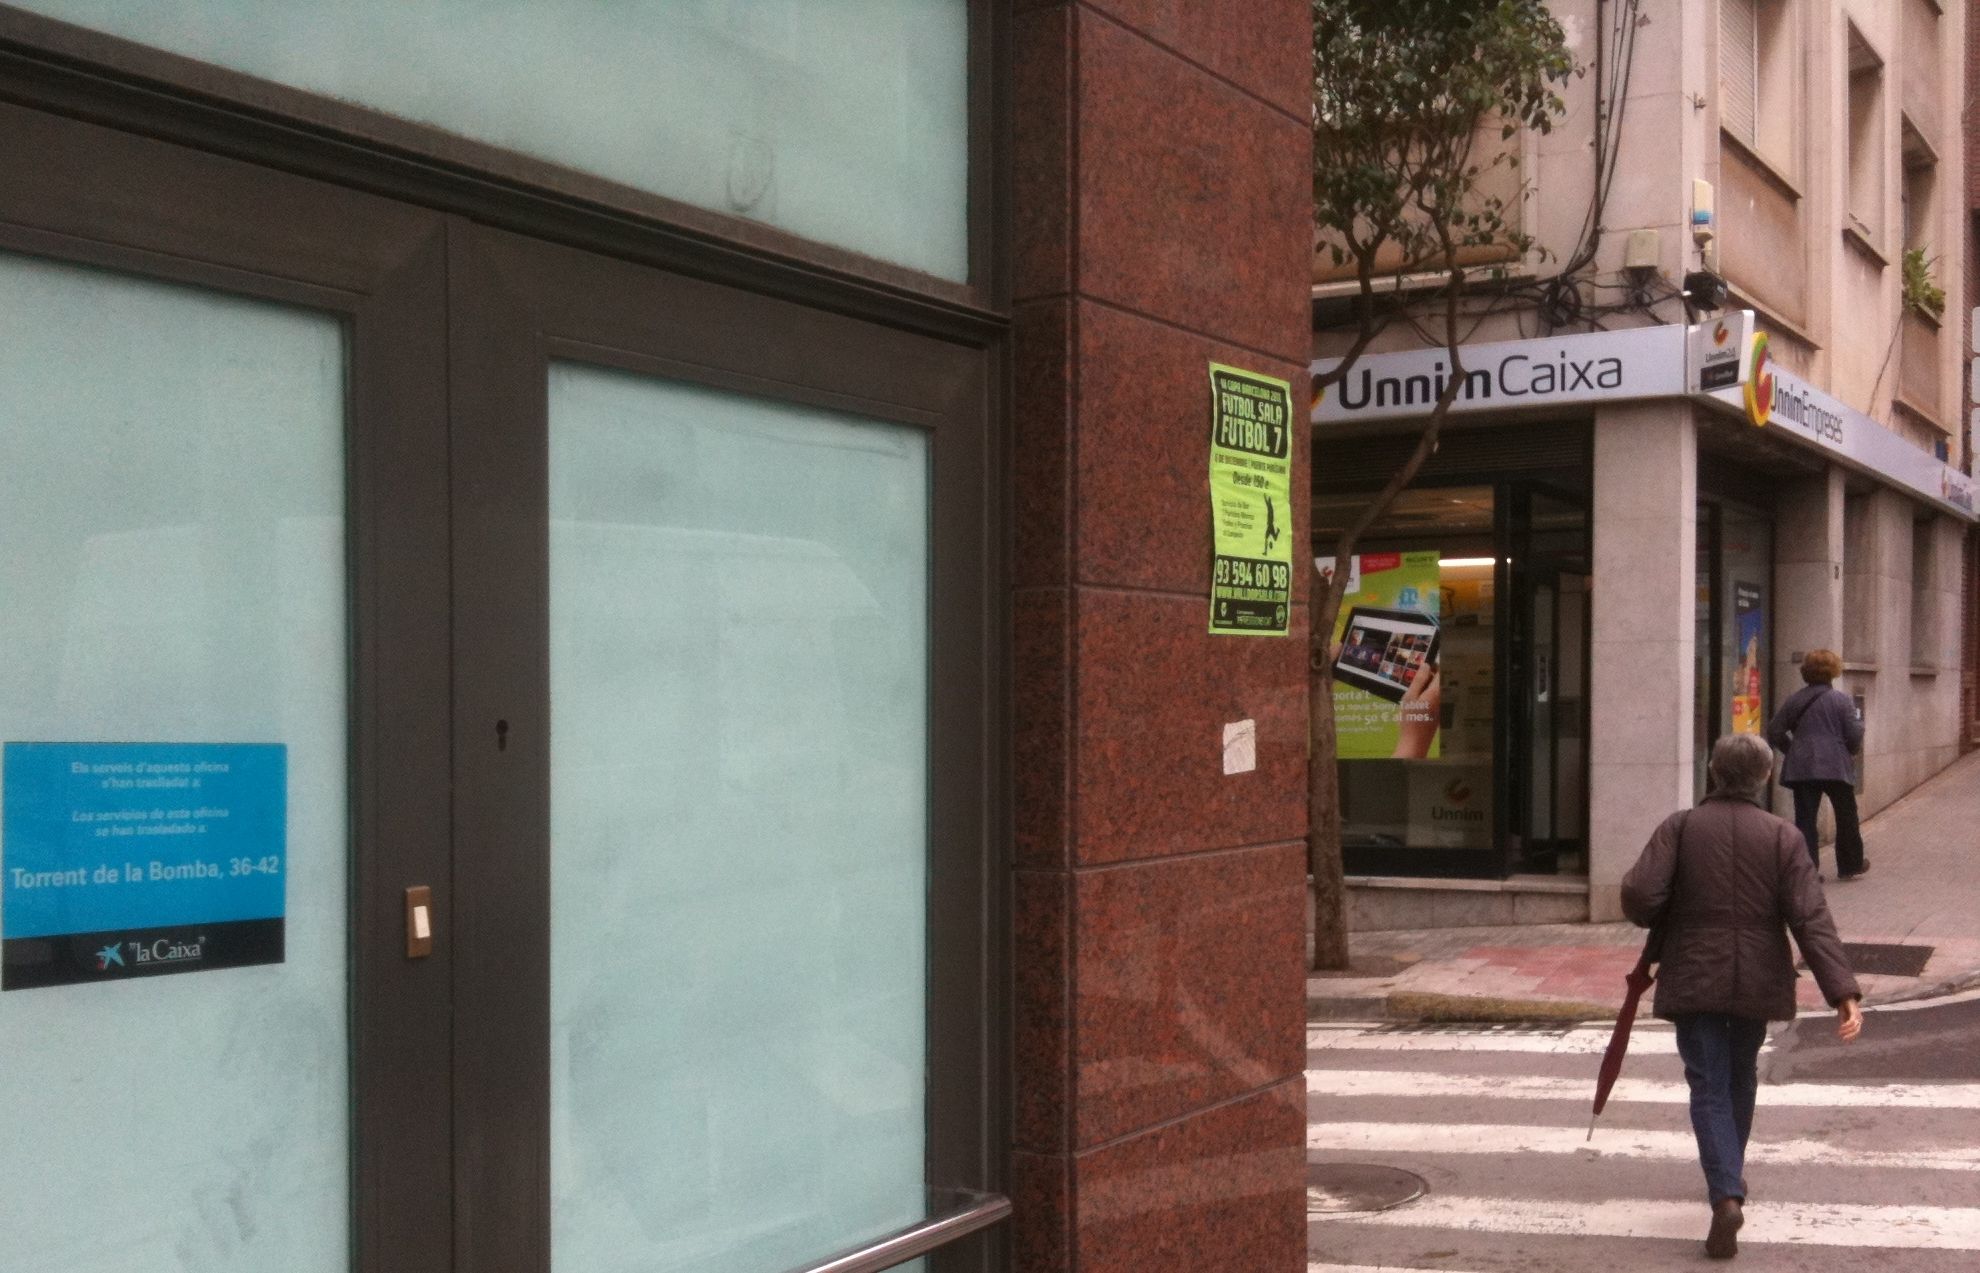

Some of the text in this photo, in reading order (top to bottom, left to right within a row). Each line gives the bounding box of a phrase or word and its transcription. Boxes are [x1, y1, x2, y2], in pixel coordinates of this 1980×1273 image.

[1221, 391, 1256, 420] FUTBOL
[1258, 401, 1283, 426] SALA
[1220, 414, 1282, 454] FUTBOL 7
[1216, 558, 1287, 589] 93 594 60 98
[149, 807, 165, 820] de
[1431, 806, 1484, 820] Unnim
[11, 856, 280, 889] Torrent de la Bomba, 36-42
